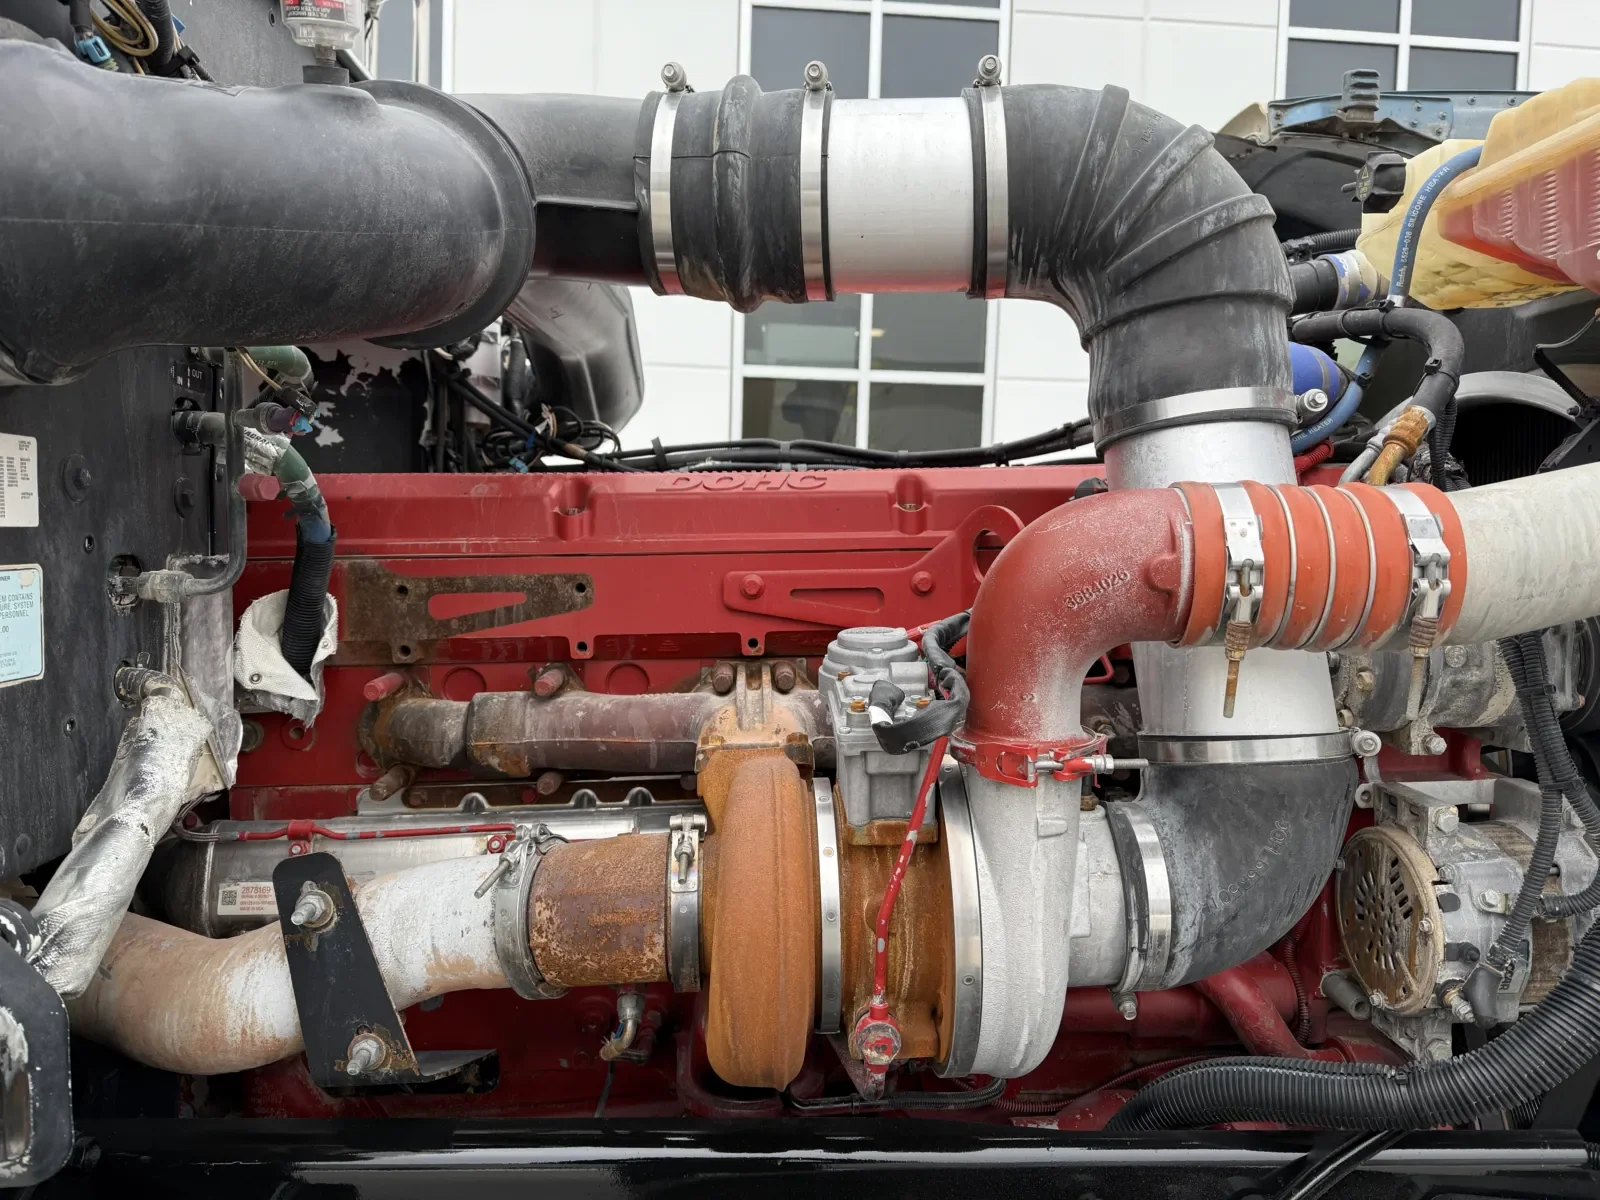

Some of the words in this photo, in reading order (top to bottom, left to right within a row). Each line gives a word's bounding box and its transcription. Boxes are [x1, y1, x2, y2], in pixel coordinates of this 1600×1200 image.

[1408, 194, 1427, 227] SILICONE
[1425, 166, 1450, 193] HEATER
[191, 368, 203, 380] OUT
[176, 375, 183, 386] IN
[1308, 417, 1334, 434] HEATER
[656, 473, 828, 492] DOHC
[8, 593, 33, 602] CONTAINS
[14, 601, 34, 610] SYSTEM
[241, 885, 271, 895] 2878169
